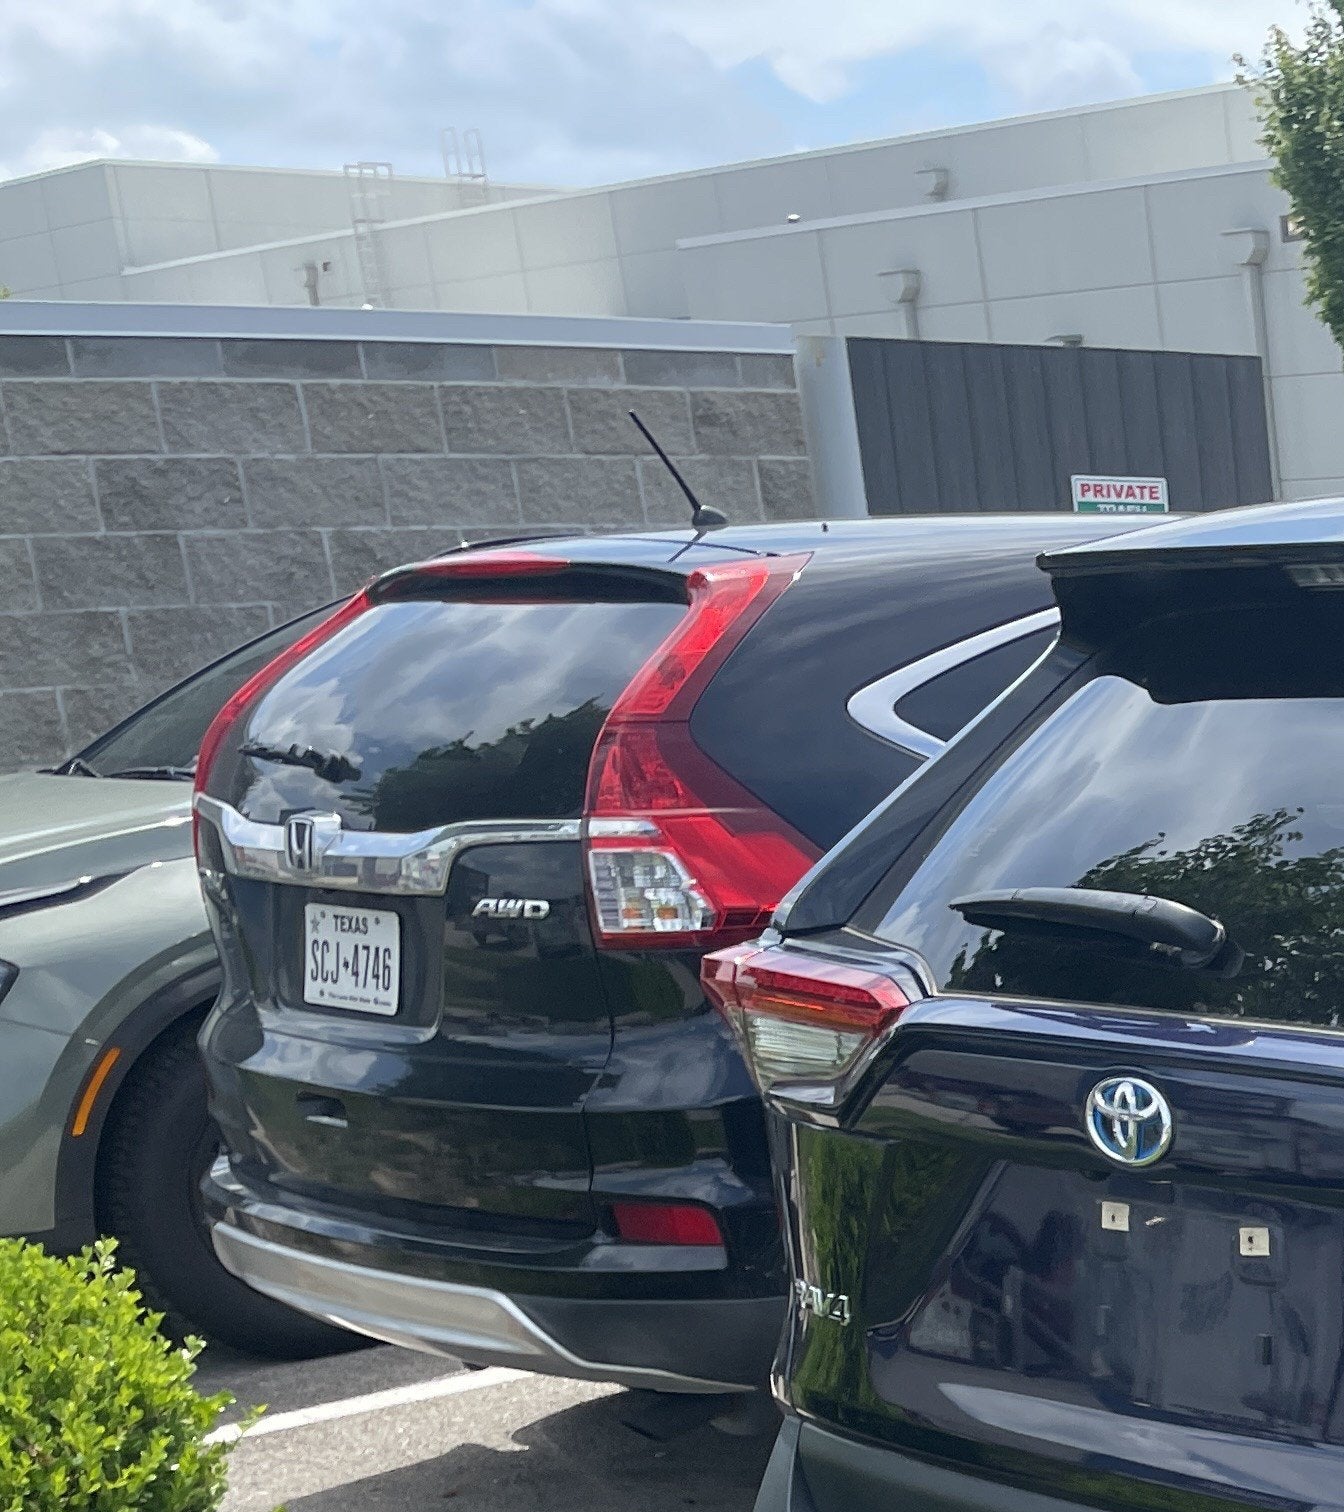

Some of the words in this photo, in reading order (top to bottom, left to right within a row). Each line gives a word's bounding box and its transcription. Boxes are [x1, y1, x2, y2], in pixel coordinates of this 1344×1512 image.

[1080, 483, 1160, 500] PRIVATE
[471, 898, 551, 920] AWD
[332, 913, 369, 936] TEXAS
